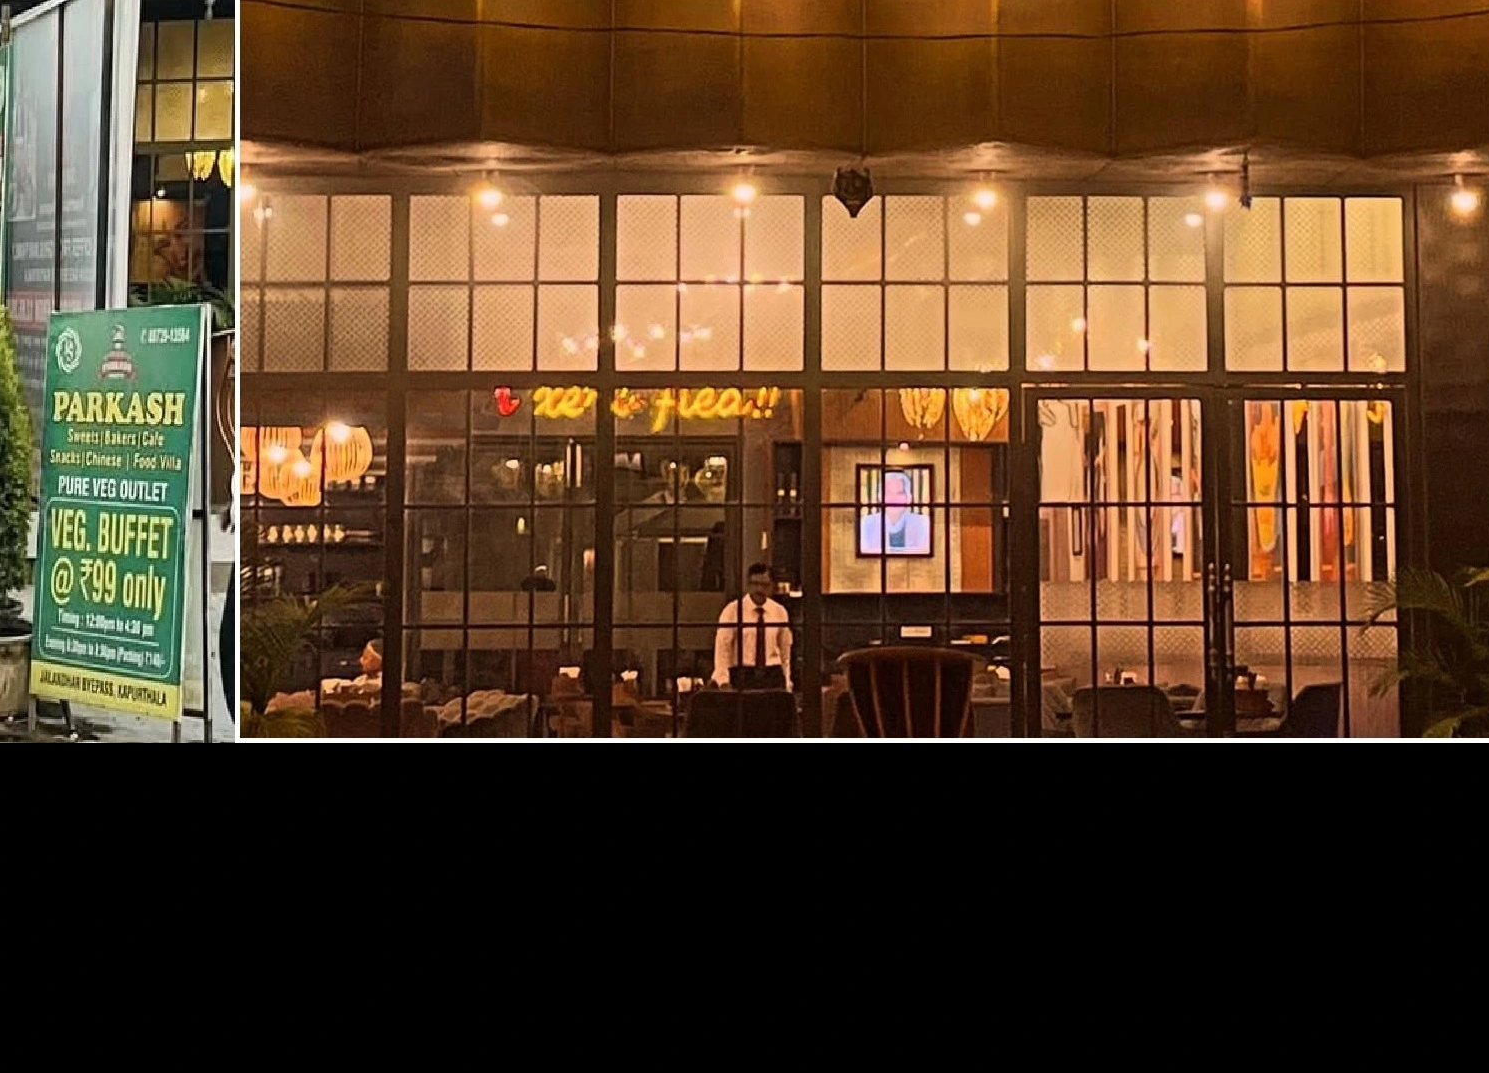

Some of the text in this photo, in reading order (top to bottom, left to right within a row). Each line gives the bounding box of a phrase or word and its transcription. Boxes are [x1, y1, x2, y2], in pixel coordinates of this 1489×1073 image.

[53, 391, 186, 425] PARKASH
[58, 476, 168, 502] PURE VEG OUTLET
[51, 509, 173, 559] VEG. BUFFET
[51, 557, 73, 605] @
[123, 564, 166, 620] only
